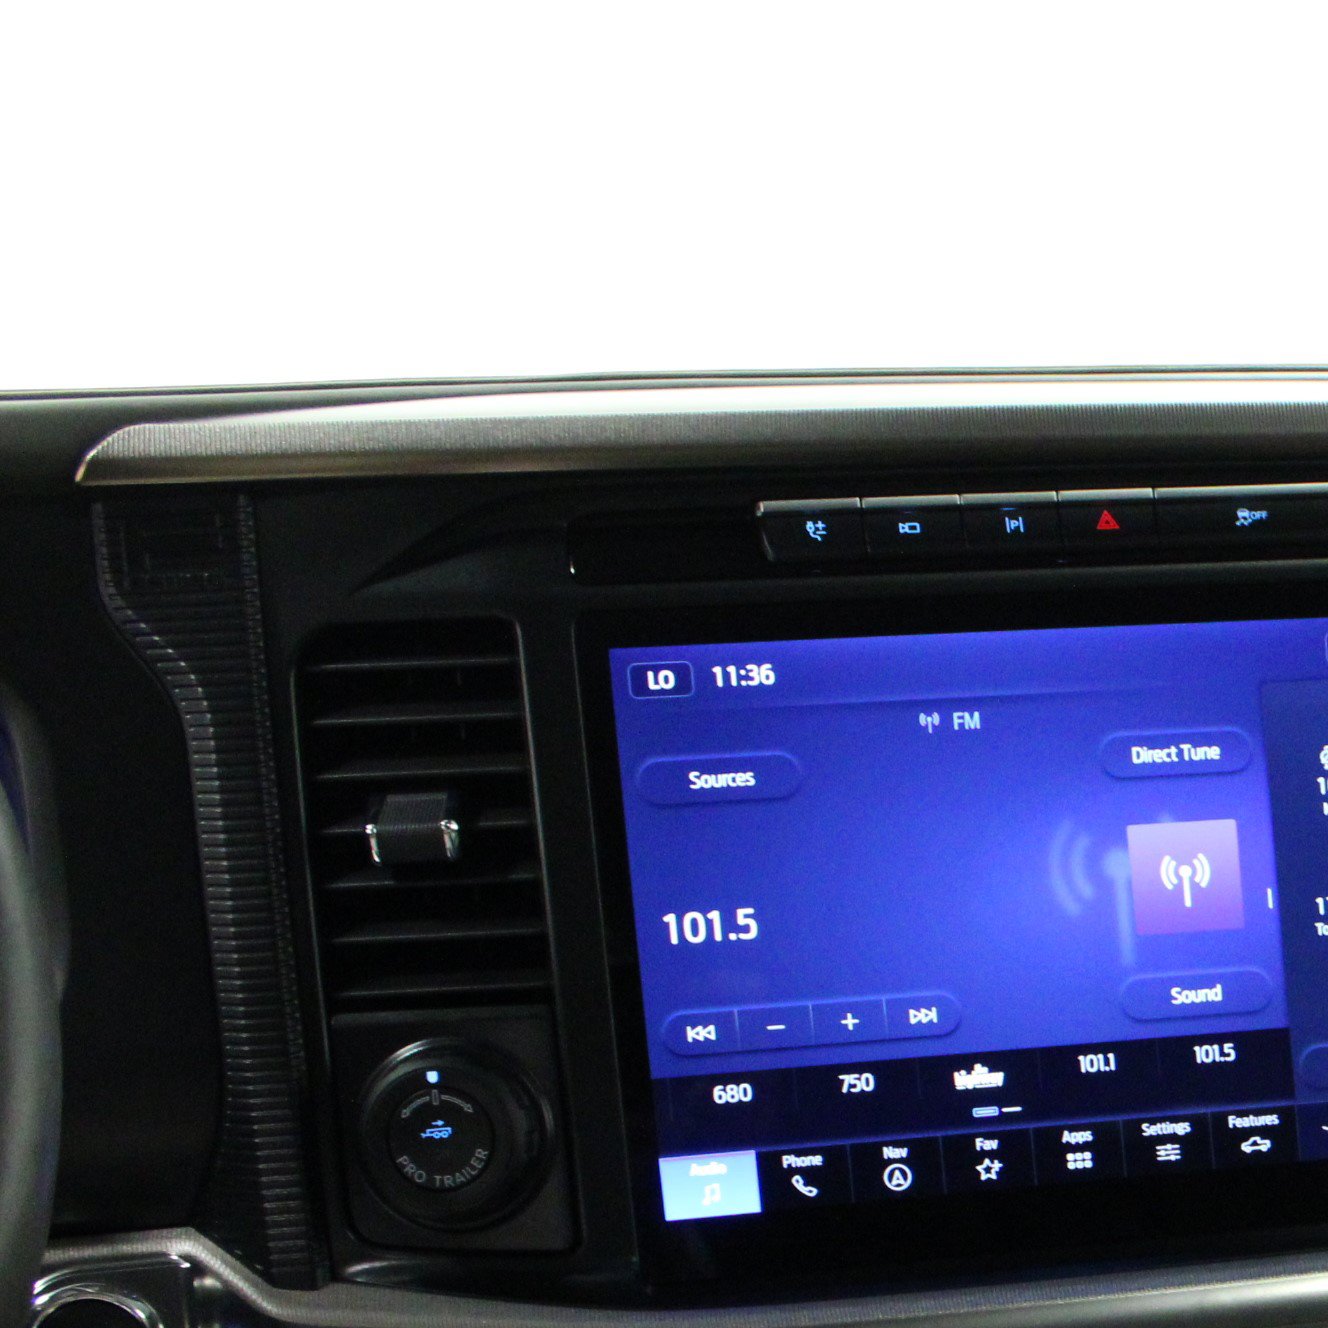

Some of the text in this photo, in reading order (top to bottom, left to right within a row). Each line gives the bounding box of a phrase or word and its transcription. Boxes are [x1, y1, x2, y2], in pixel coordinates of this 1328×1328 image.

[1251, 510, 1267, 520] OFF
[647, 670, 675, 690] LO
[711, 664, 775, 688] 11:36
[952, 711, 981, 731] FM
[1131, 743, 1221, 765] Direct Tune
[688, 769, 756, 790] Sources
[662, 907, 759, 945] 101.5
[1170, 984, 1223, 1005] Sound
[1077, 1053, 1116, 1074] 101.1
[1193, 1044, 1236, 1064] 101.5
[838, 1072, 875, 1093] 750
[713, 1083, 753, 1104] 680
[1141, 1121, 1192, 1138] Settings
[1228, 1113, 1280, 1129] Features
[975, 1137, 1000, 1152] Fav
[1061, 1129, 1093, 1146] Apps
[781, 1152, 824, 1169] Phone
[883, 1146, 909, 1161] Nav
[396, 1148, 491, 1188] PRO TRAILER
